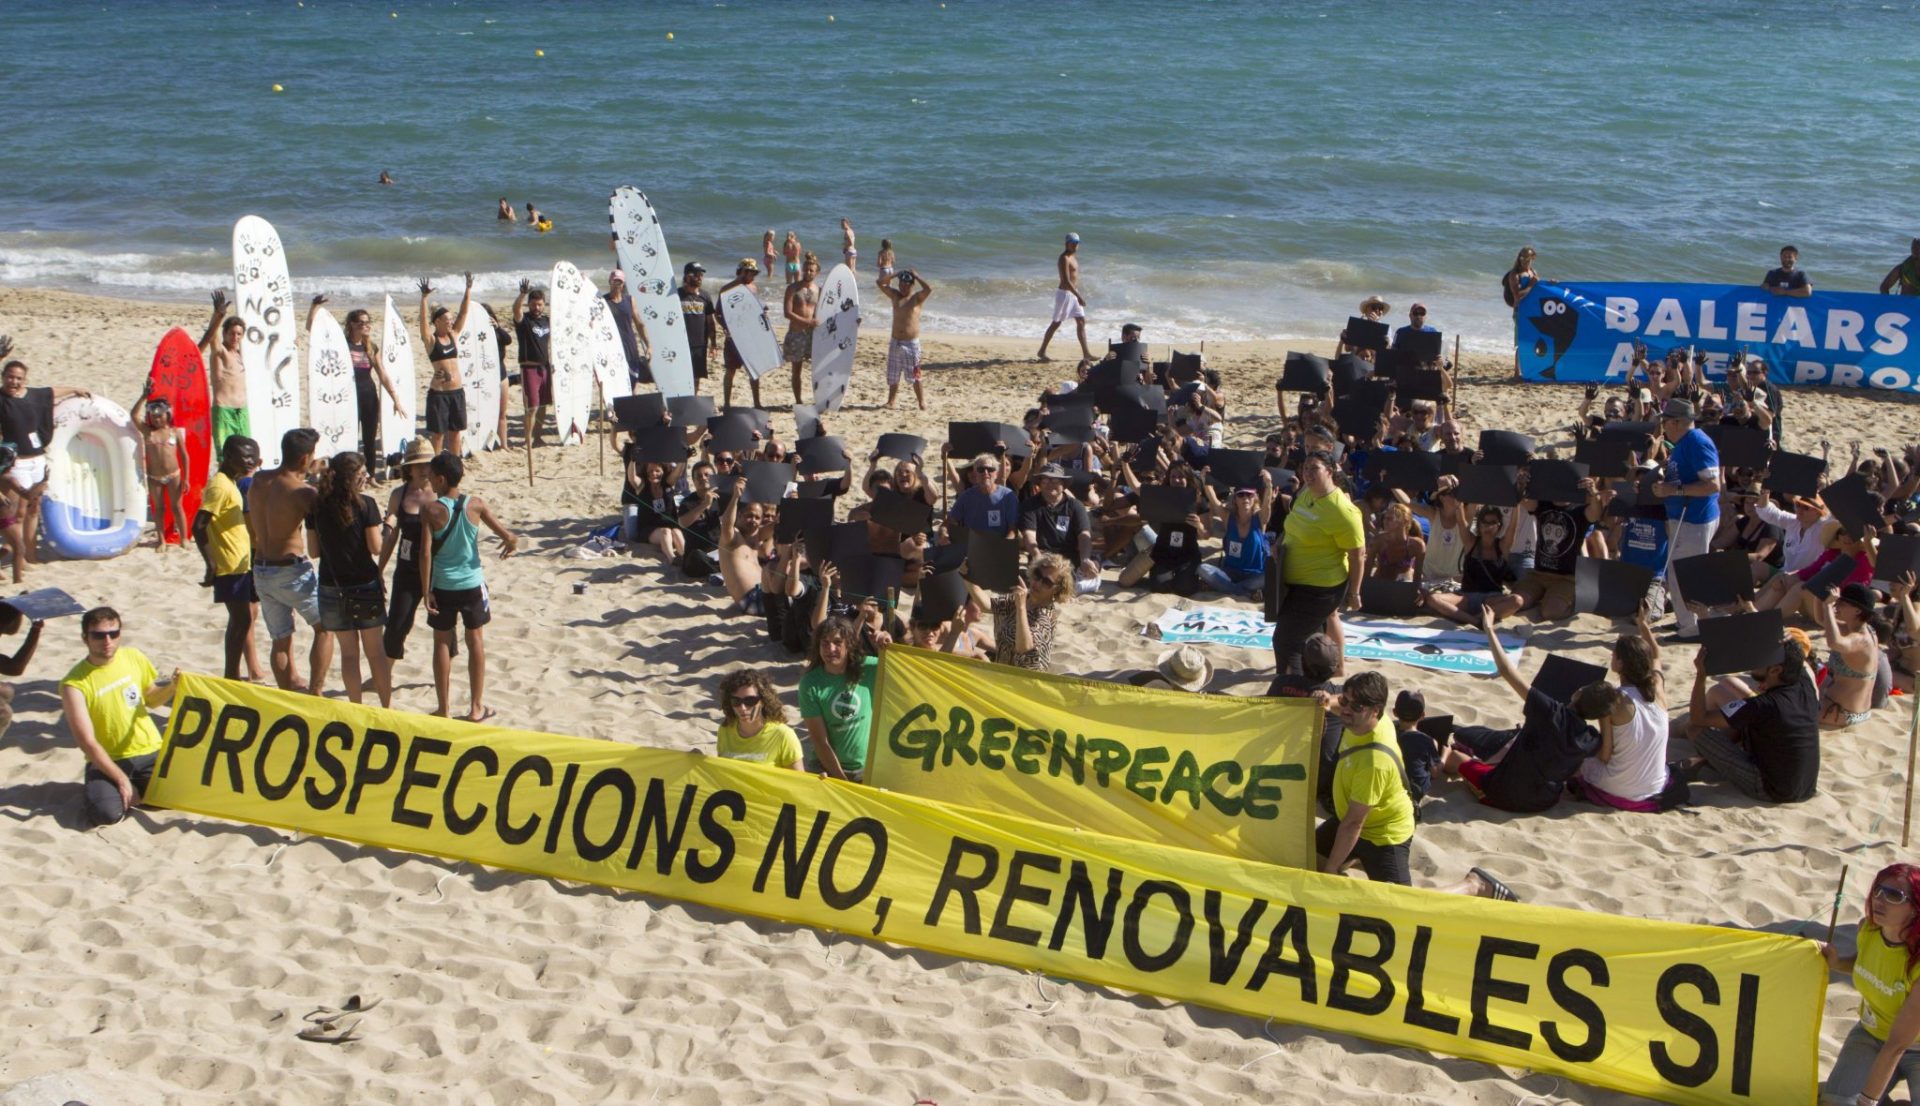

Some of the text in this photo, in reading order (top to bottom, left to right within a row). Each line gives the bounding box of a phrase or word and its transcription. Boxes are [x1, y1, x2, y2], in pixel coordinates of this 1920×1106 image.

[245, 295, 281, 326] NO
[1605, 296, 1911, 355] BALEARS
[161, 373, 193, 392] NO
[247, 326, 292, 391] OIL
[1794, 360, 1920, 392] PRO
[889, 703, 1307, 820] GREENPEACE
[158, 696, 1760, 1098] PROSPECCIONS NO, RENOVABLES SI
